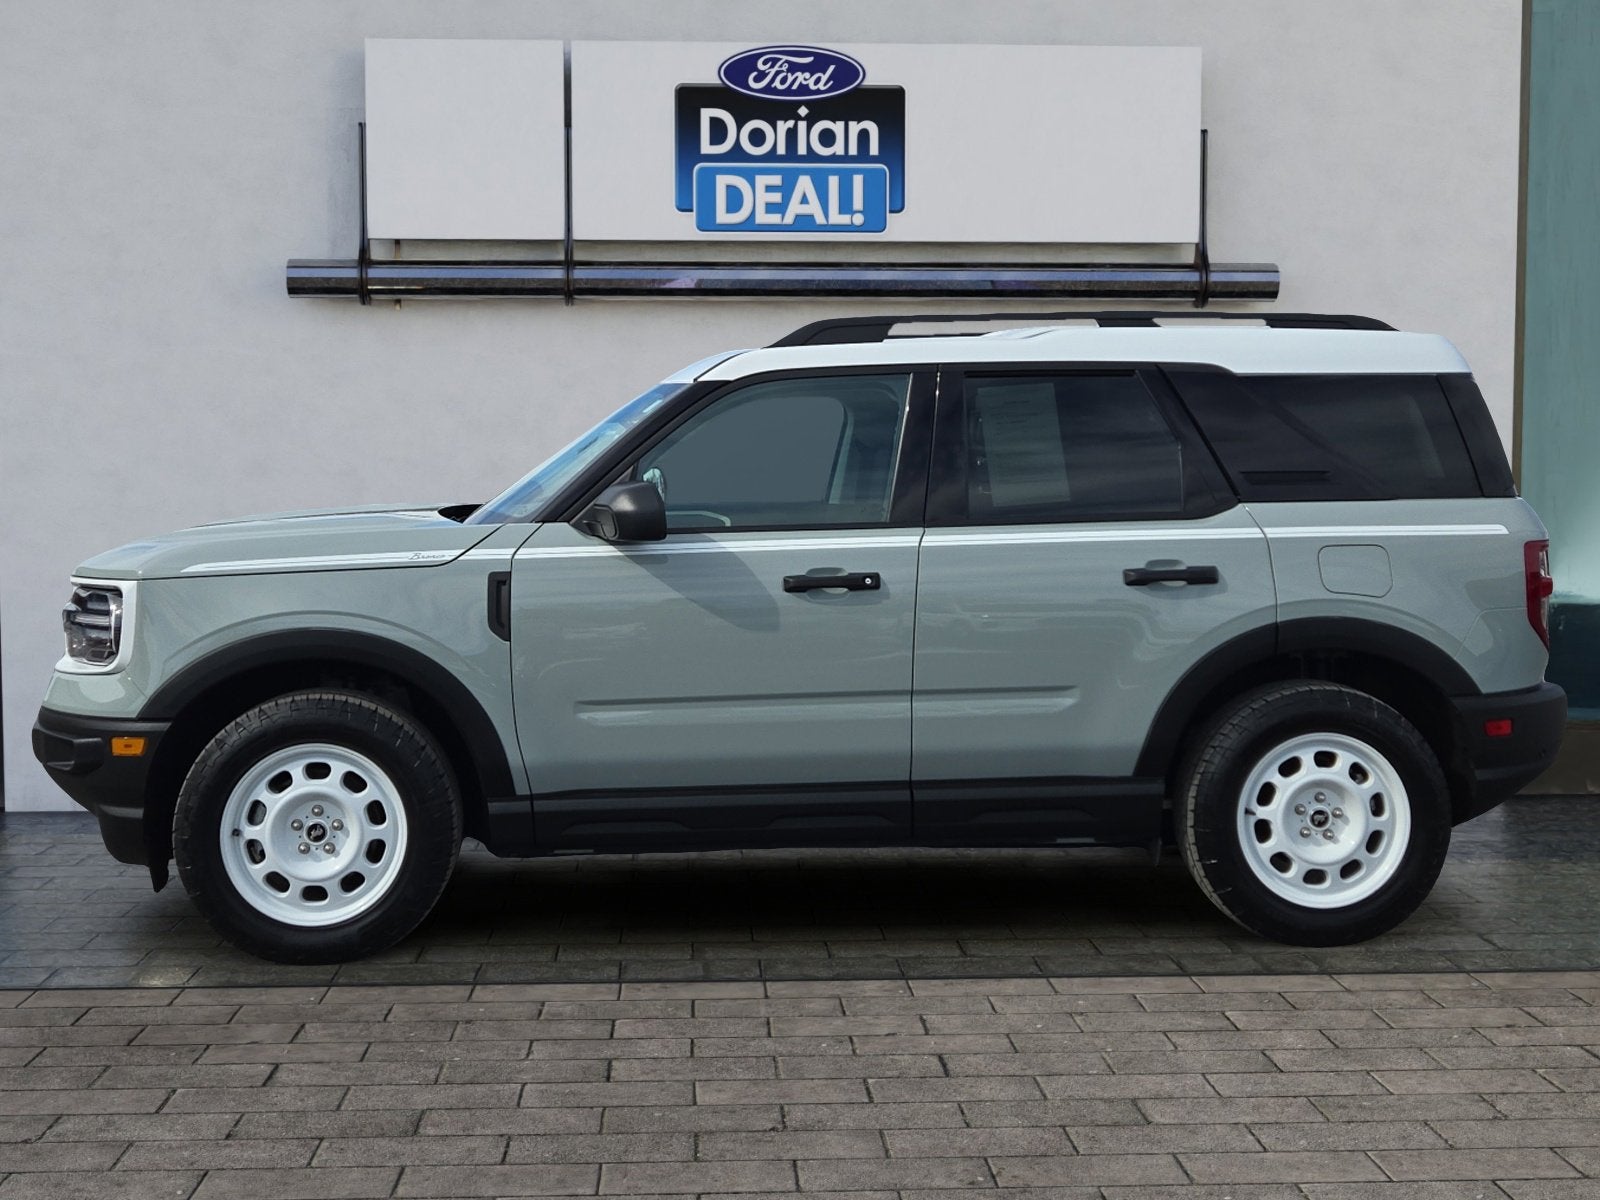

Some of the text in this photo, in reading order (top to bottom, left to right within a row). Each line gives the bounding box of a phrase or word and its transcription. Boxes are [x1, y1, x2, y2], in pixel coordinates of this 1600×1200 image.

[748, 54, 836, 91] Ford
[700, 105, 879, 156] Dorian
[715, 174, 865, 226] DEAL!
